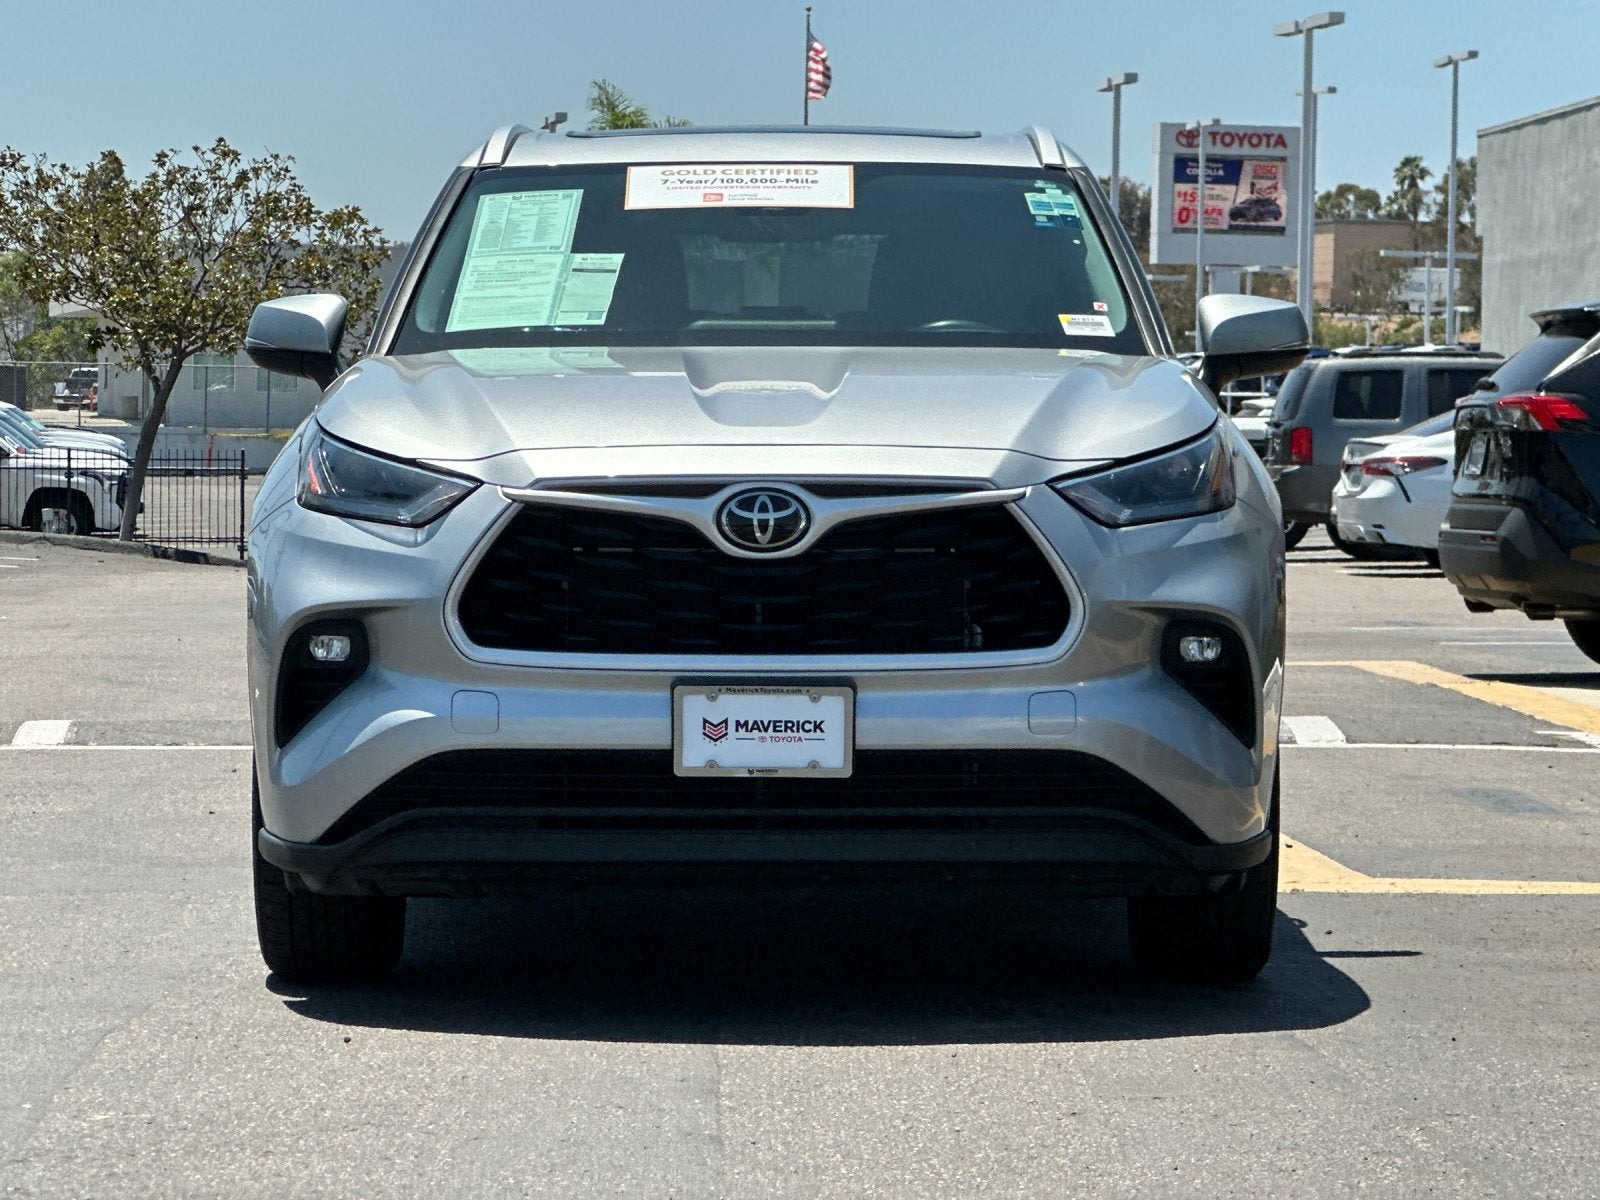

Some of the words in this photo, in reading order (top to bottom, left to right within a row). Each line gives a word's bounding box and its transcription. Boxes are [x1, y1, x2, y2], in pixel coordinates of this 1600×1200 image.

[1208, 131, 1288, 149] TOYOTA
[721, 168, 818, 176] CERTIFIED
[661, 177, 819, 185] 7-Year/100,000-Mile
[735, 720, 825, 733] MAVERICK
